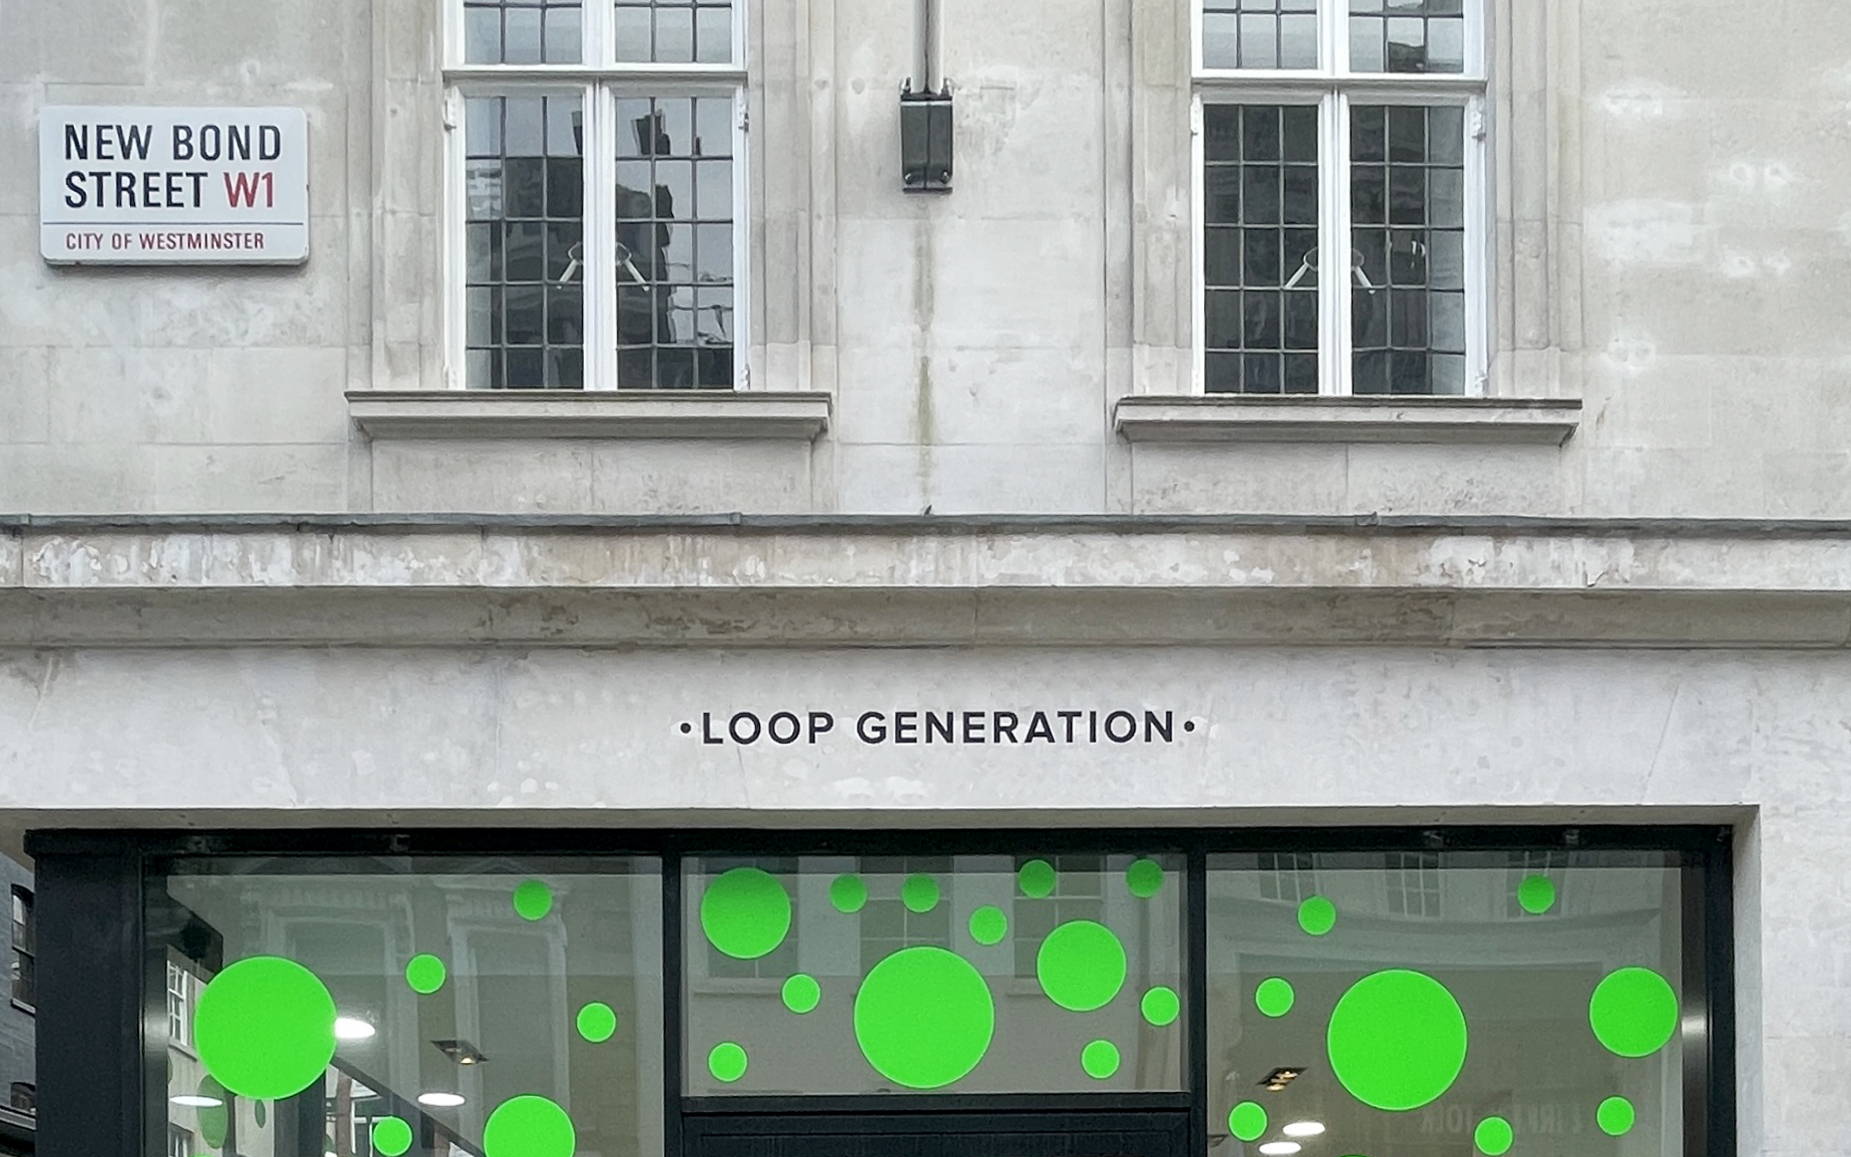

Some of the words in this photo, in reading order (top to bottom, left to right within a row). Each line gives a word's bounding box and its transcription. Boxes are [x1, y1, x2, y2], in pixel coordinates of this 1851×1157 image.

[65, 124, 153, 161] NEW
[172, 124, 281, 161] BOND
[64, 170, 209, 209] STREET
[223, 171, 275, 208] W1
[66, 232, 104, 250] CITY
[112, 232, 132, 250] OF
[139, 232, 265, 250] WESTMINSTER
